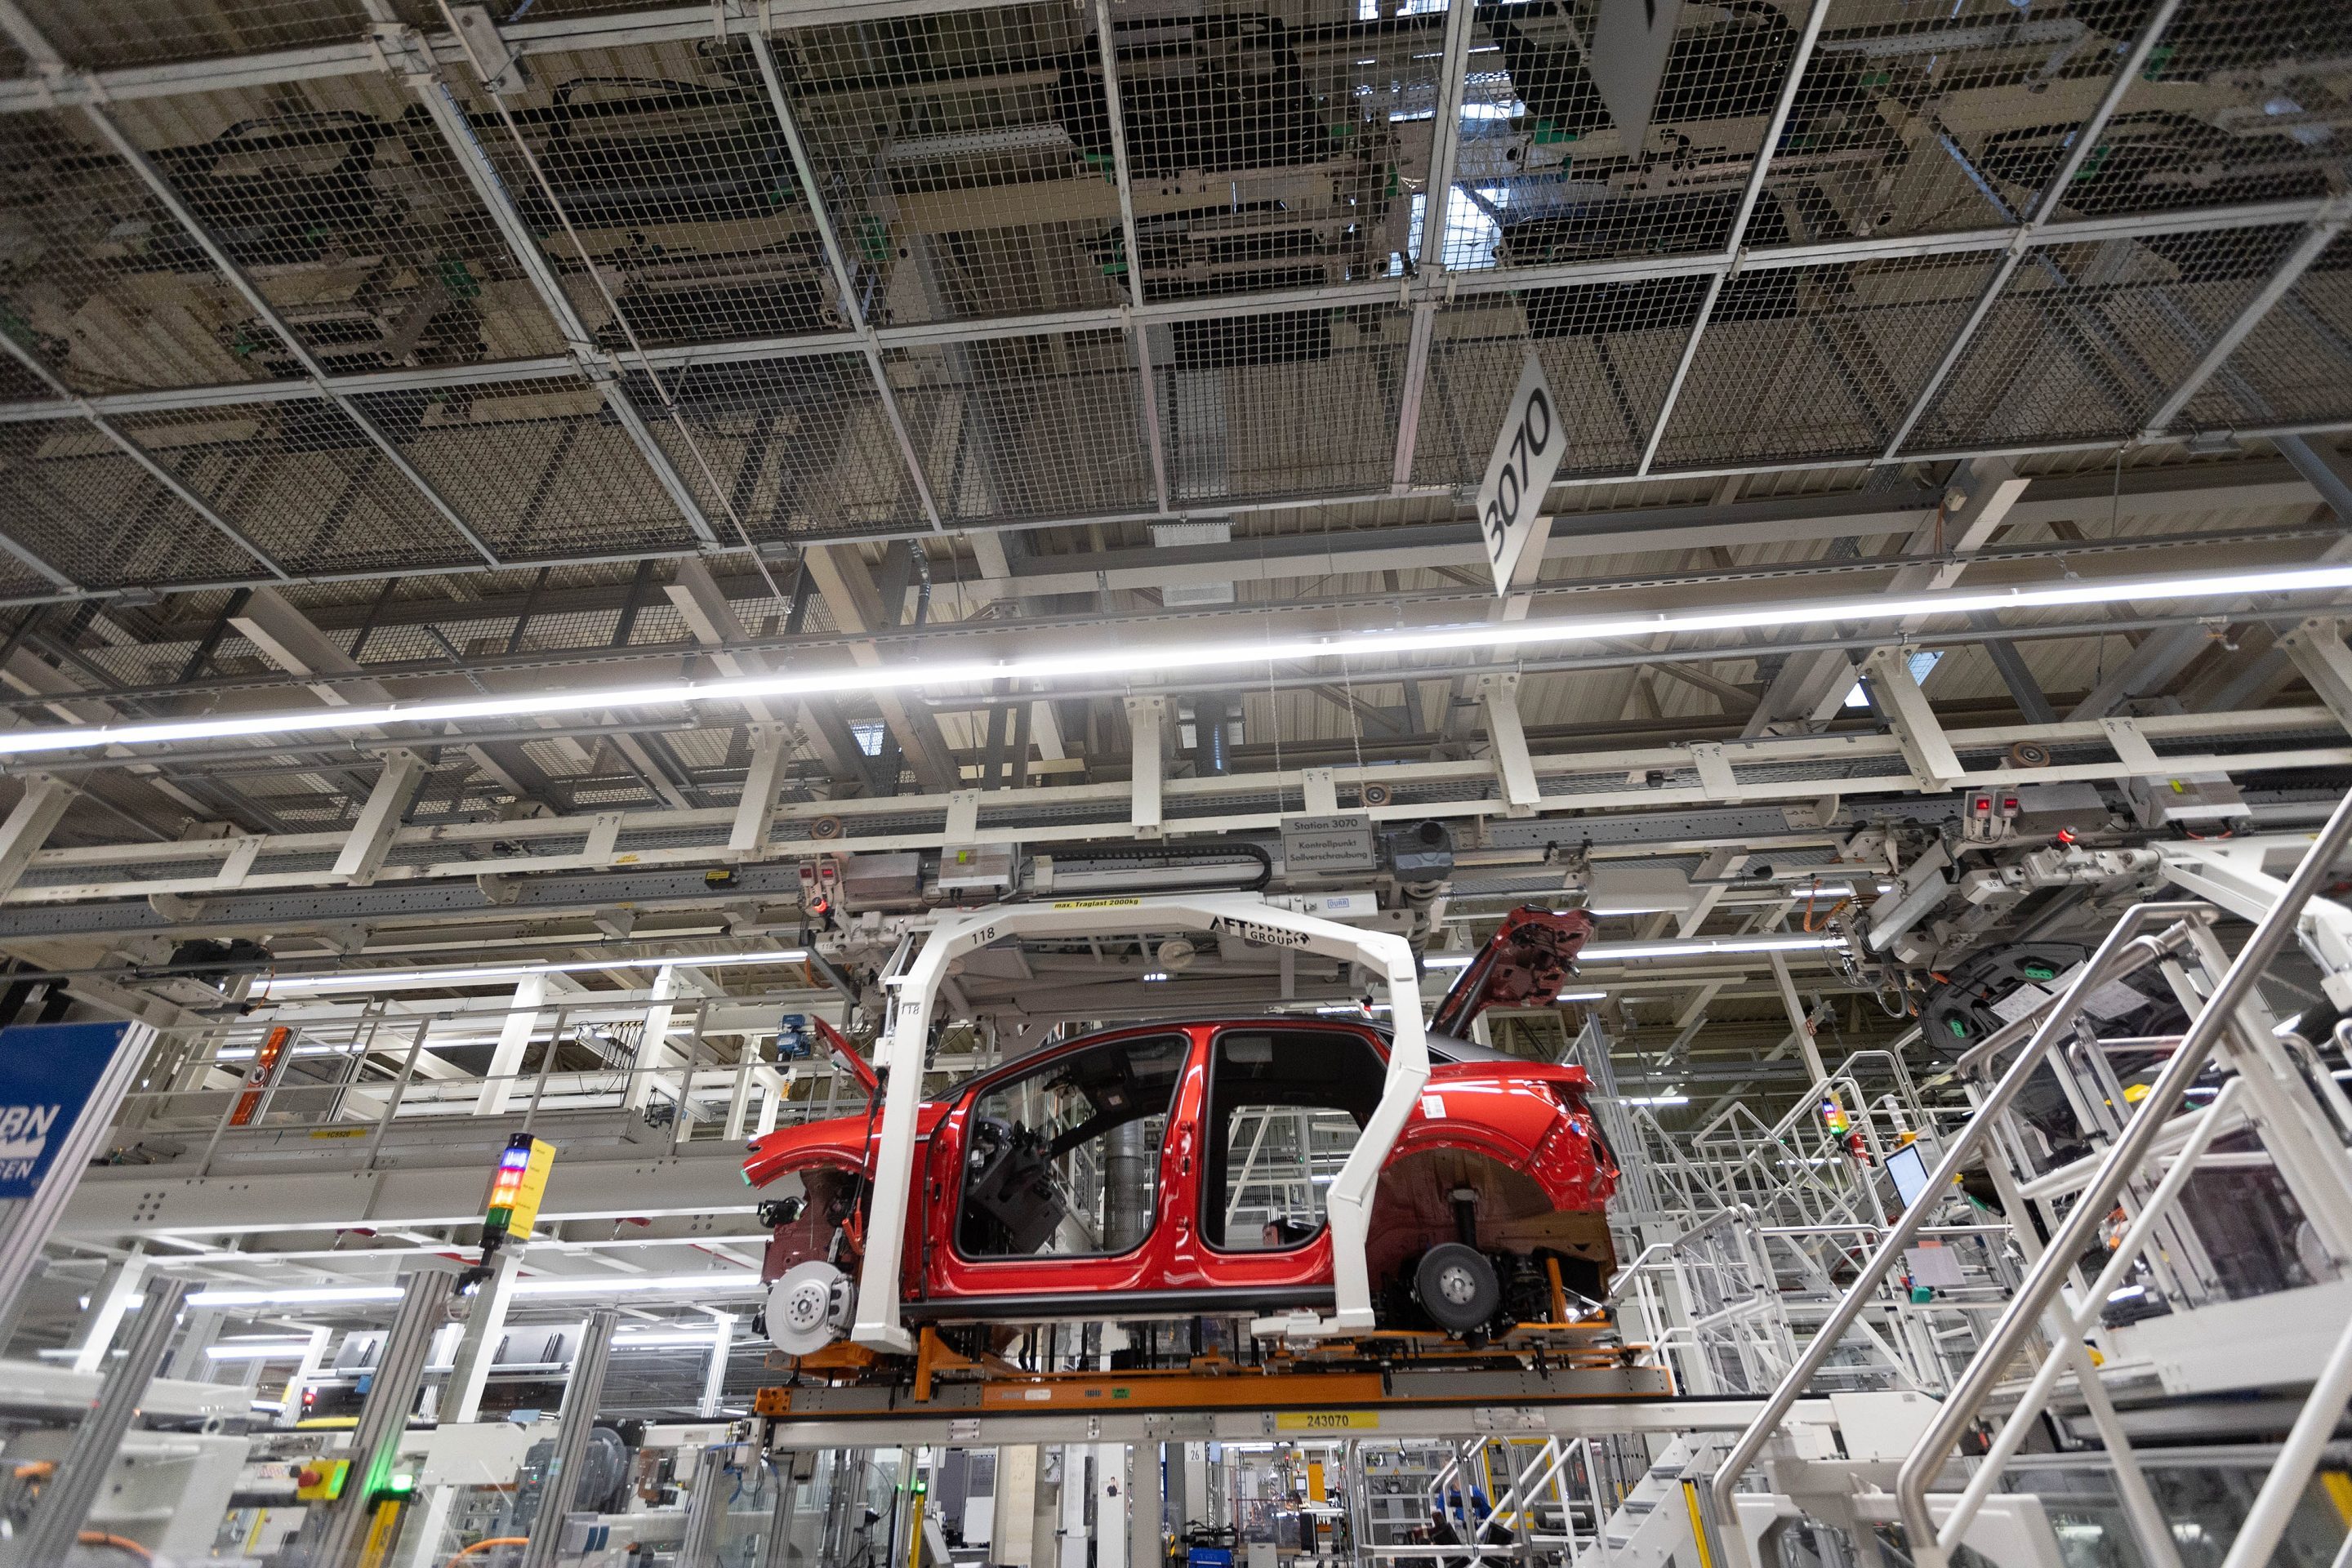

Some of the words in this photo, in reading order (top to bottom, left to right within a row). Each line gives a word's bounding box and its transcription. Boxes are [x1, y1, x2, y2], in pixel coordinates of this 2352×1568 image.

[1485, 387, 1551, 565] 3070
[1294, 821, 1330, 831] Station
[1332, 819, 1358, 828] 3070
[1298, 839, 1356, 850] Kontrollpunkt
[1290, 851, 1368, 862] Sollverschraubung
[1209, 915, 1247, 938] AFT
[972, 927, 995, 945] 118
[1250, 930, 1293, 947] GROUP
[901, 1005, 920, 1014] 118
[0, 1104, 61, 1136] BN
[1307, 1415, 1349, 1428] 243070
[1191, 1450, 1200, 1461] 26
